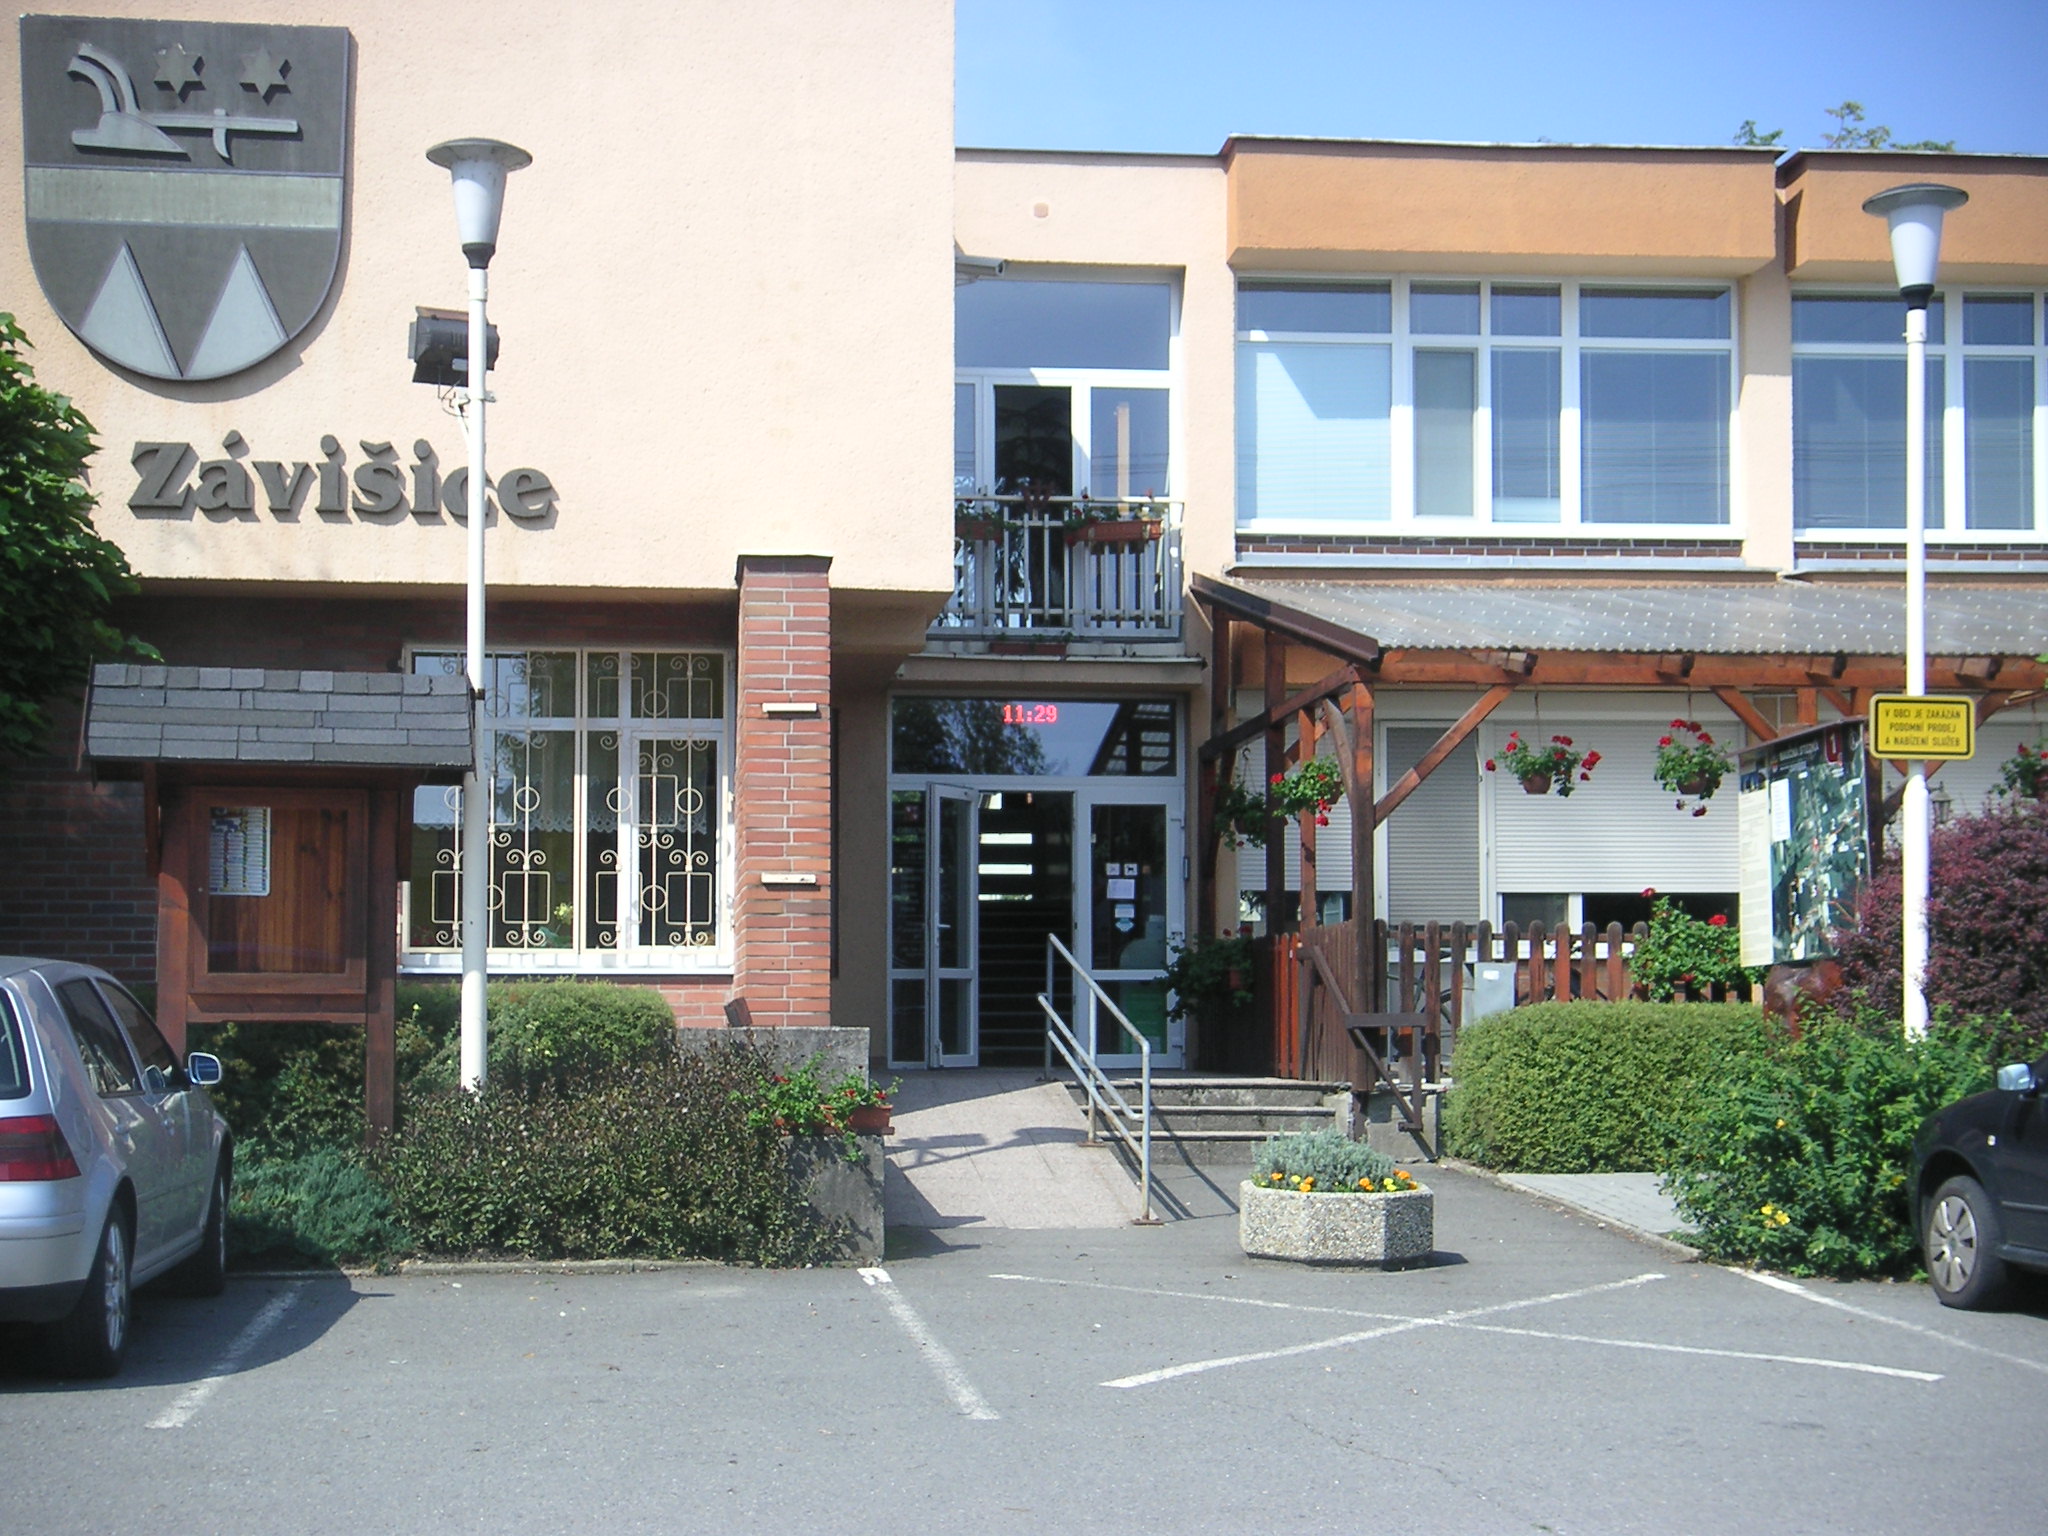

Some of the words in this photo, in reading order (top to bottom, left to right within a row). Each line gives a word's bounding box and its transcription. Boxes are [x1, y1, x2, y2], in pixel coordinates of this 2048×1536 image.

[128, 430, 556, 522] Závišice
[1003, 704, 1057, 722] 11:29
[1885, 708, 1890, 717] V
[1914, 708, 1923, 718] JE
[1927, 722, 1957, 733] PRODEJ
[1830, 732, 1837, 754] 1
[1885, 736, 1890, 745] A
